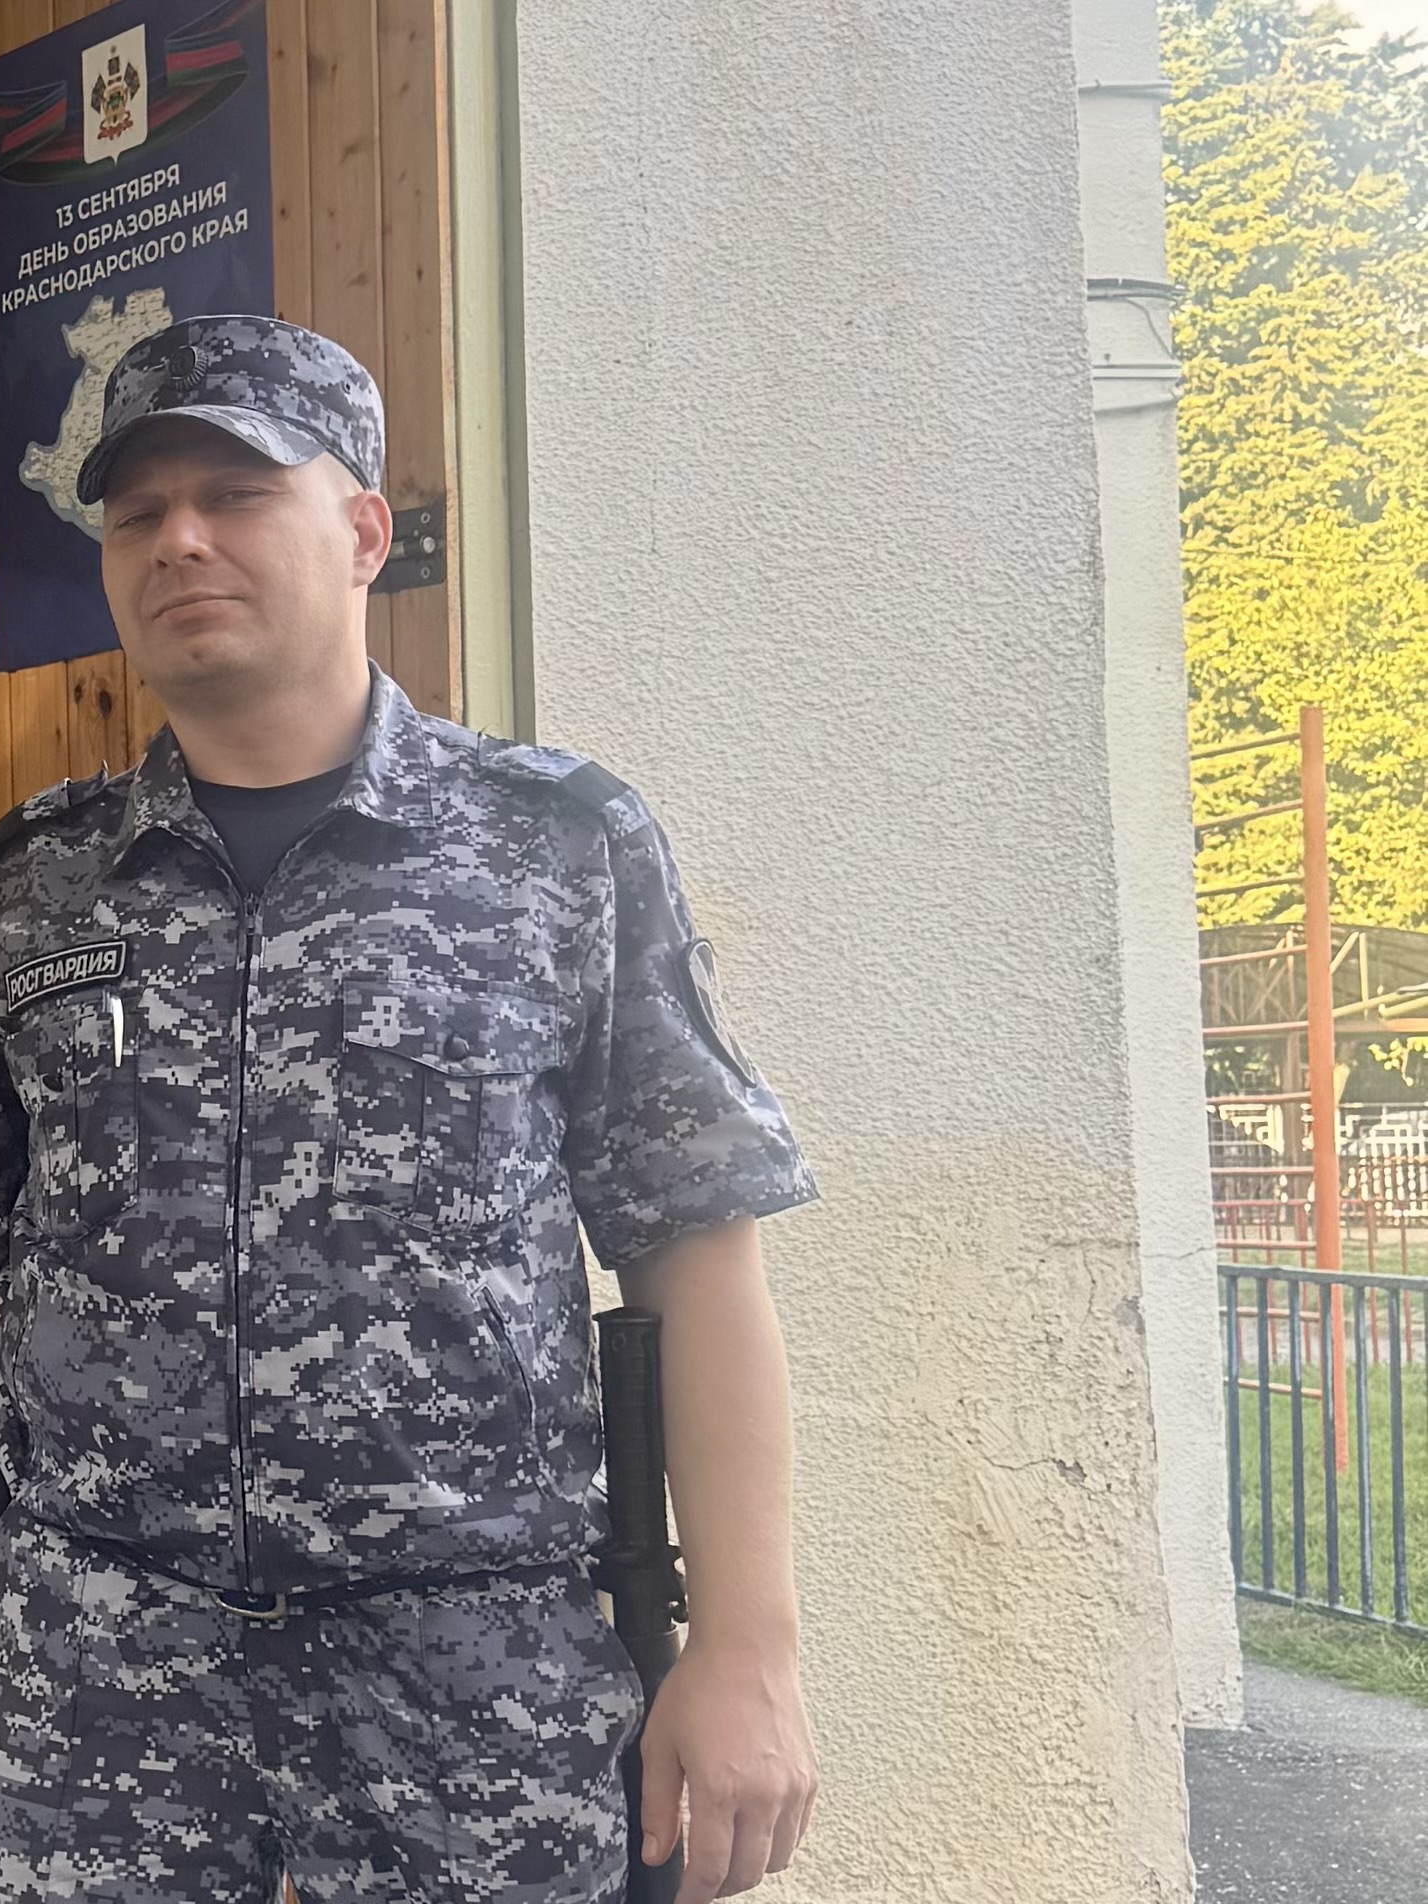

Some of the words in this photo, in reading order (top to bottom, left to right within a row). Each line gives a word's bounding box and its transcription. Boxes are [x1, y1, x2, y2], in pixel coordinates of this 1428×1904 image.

[18, 240, 68, 279] ДЕНЬ
[74, 181, 226, 255] ОБРАЗОВАНИЯ
[56, 204, 73, 229] 13
[78, 164, 179, 220] СЕНТЯБРЯ
[2, 231, 185, 314] КРАСНОДАРСКОГО
[192, 208, 248, 248] КРАЯ
[11, 950, 116, 1002] РОСГВАРДИЯ
